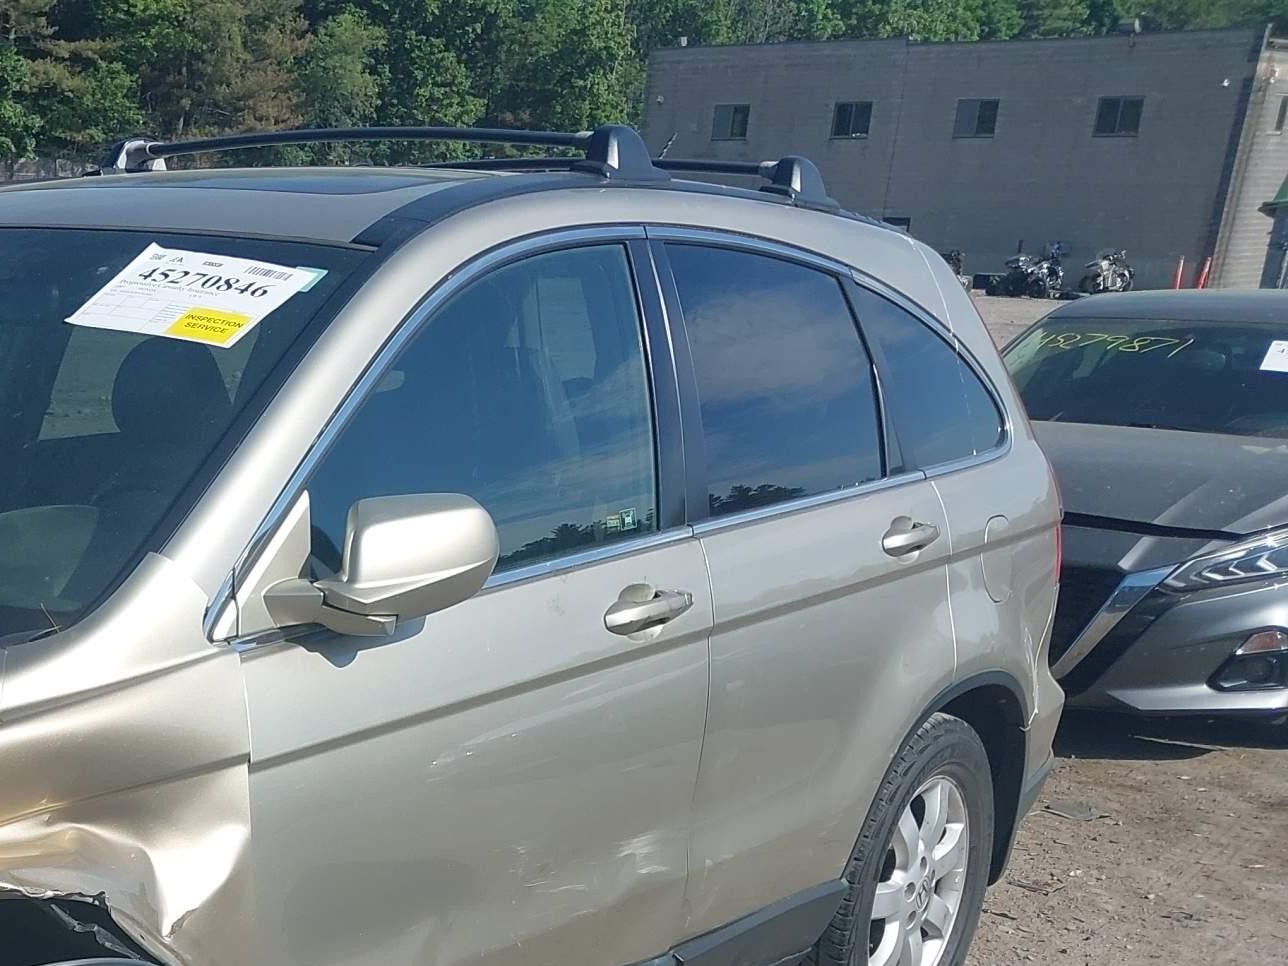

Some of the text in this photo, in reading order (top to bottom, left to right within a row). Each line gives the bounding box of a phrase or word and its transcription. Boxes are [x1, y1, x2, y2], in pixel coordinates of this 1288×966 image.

[137, 266, 278, 298] 45270846
[183, 321, 230, 334] SERVICE
[184, 313, 245, 329] INSPECTION
